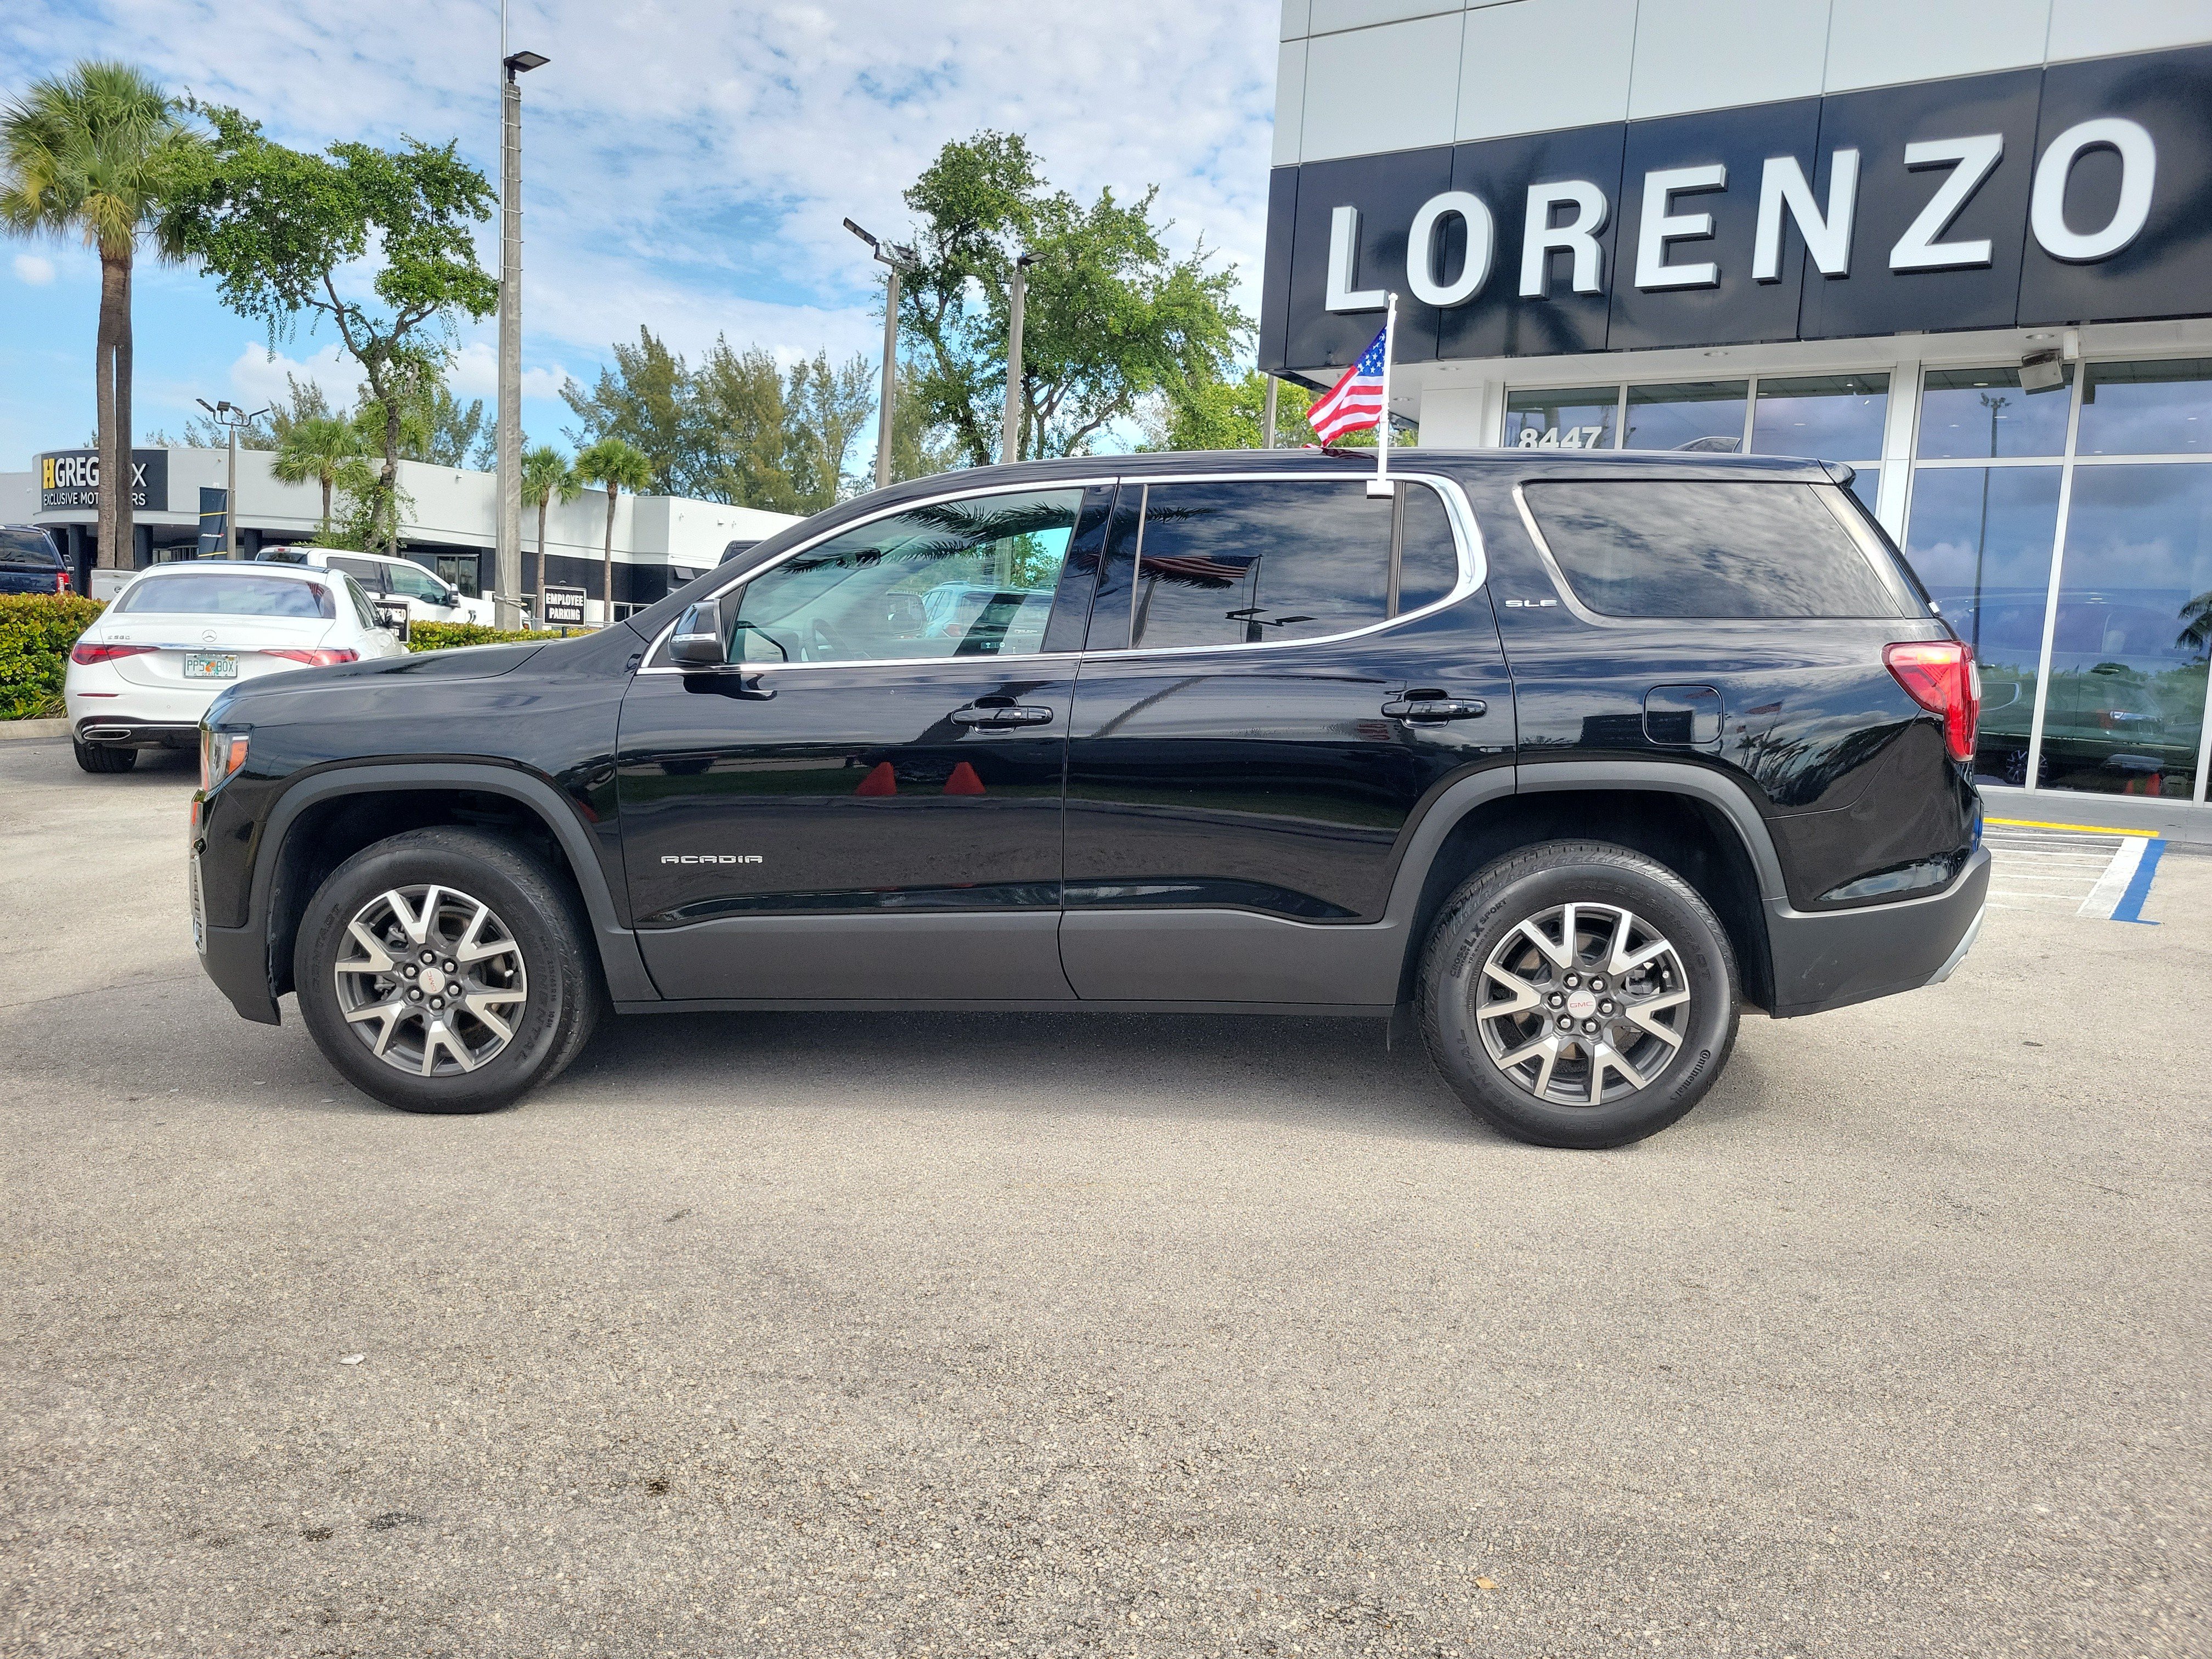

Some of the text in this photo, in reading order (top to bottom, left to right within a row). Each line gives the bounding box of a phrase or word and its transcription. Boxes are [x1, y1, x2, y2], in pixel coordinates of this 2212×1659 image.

[1325, 117, 2156, 312] LORENZO
[1518, 426, 1602, 449] 8447
[44, 492, 78, 506] EXCLUSIVE
[545, 592, 584, 607] EMPLOYEE
[549, 607, 580, 620] PARKING
[187, 660, 205, 672] PP5
[661, 855, 763, 864] ACADIA
[1480, 898, 1506, 924] SPORT
[427, 970, 437, 991] GMC
[1675, 1049, 1711, 1097] Continental
